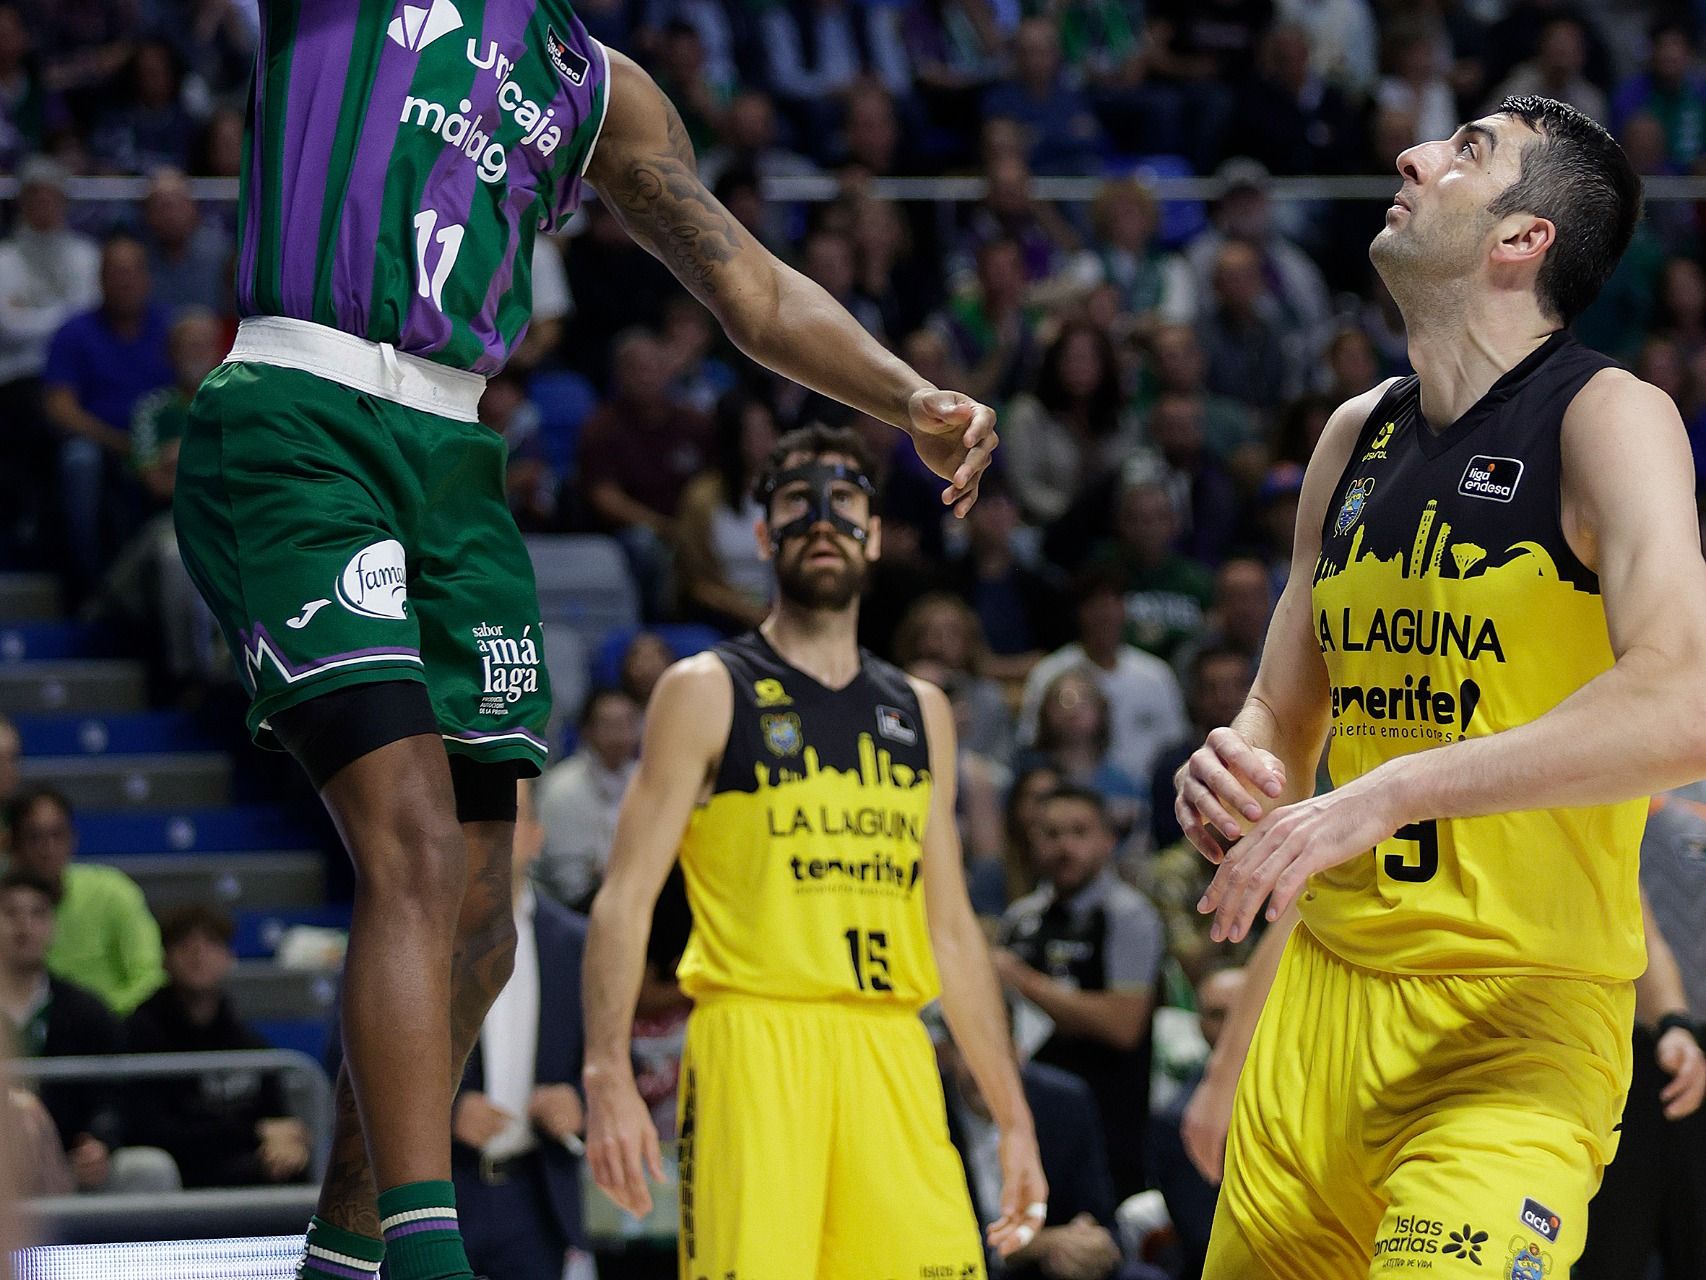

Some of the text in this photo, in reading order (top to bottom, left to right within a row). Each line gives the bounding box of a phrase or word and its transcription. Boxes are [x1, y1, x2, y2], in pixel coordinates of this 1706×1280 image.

[414, 209, 465, 312] 11
[1469, 468, 1490, 481] liga
[1465, 481, 1510, 496] endesa
[472, 622, 503, 637] sabor
[1319, 607, 1506, 663] A LAGUNA
[477, 639, 489, 652] a
[1329, 674, 1481, 741] enerife!
[767, 807, 813, 837] LA
[1394, 1215, 1444, 1236] Islas
[1525, 1210, 1551, 1235] acb
